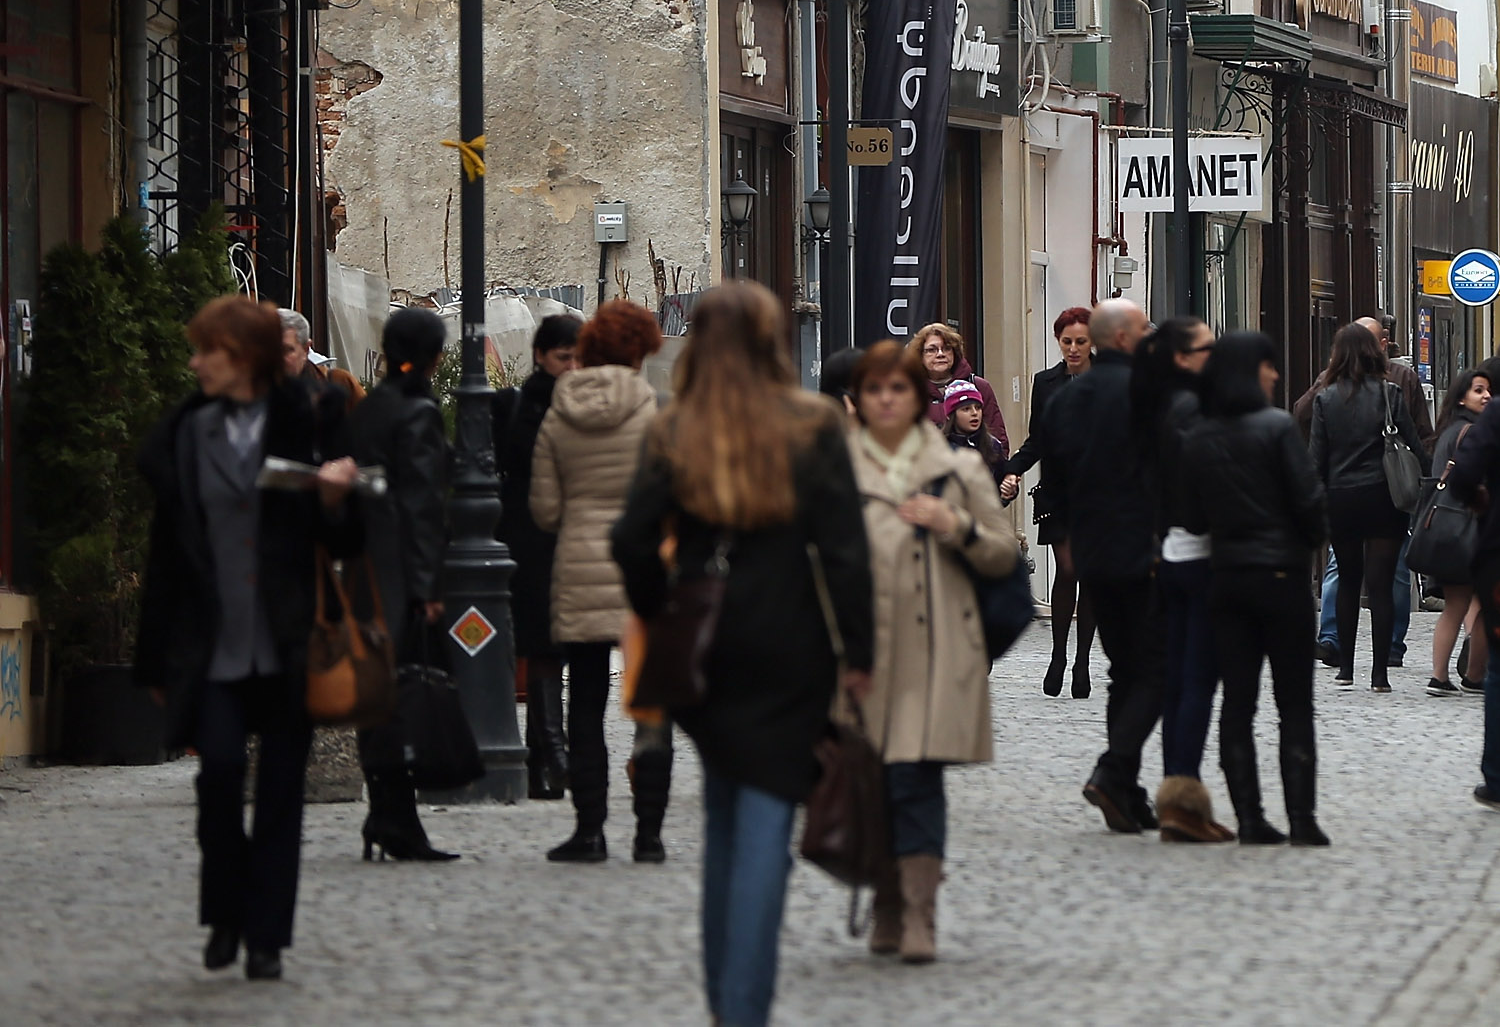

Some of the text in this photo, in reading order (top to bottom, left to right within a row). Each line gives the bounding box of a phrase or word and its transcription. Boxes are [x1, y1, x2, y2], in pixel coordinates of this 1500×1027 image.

[1411, 51, 1457, 79] TERII AUR
[847, 138, 889, 153] No.56
[1412, 123, 1475, 204] cani 40
